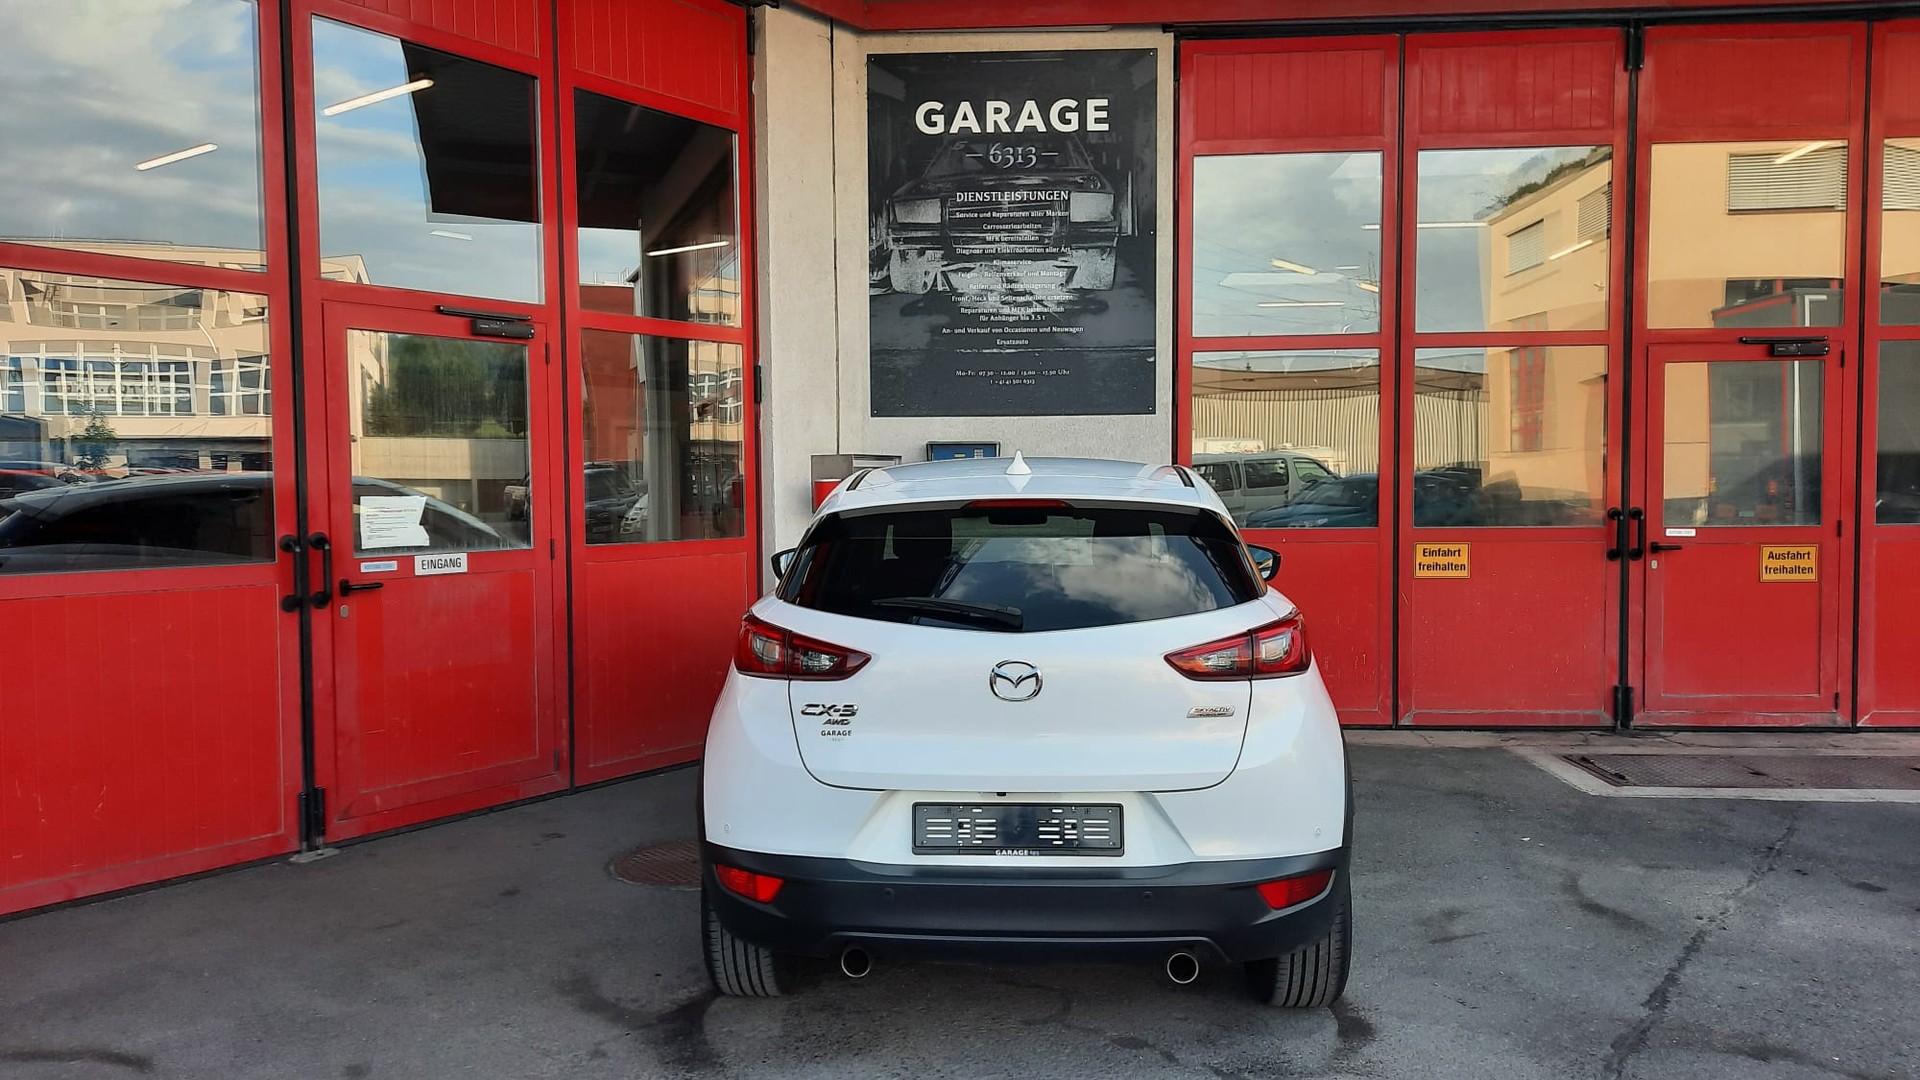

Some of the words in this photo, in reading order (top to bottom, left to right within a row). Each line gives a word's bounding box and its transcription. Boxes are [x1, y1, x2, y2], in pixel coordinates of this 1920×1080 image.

[915, 98, 1110, 135] GARAGE
[989, 142, 1037, 169] 6313
[956, 190, 1069, 202] DIENSTLEISTUNGEN
[992, 211, 1029, 219] Reparaturen
[1045, 209, 1069, 217] Marken
[955, 248, 983, 256] Diagnose
[997, 246, 1045, 254] Elektroarbeiten
[1060, 245, 1071, 253] Art
[990, 315, 1020, 323] Anhänger
[1051, 326, 1084, 334] Neuwagen
[1422, 547, 1461, 558] Einfahrt
[1767, 550, 1811, 561] Ausfahrt
[421, 557, 463, 571] EINGANG
[1418, 561, 1466, 572] freihalten
[1764, 564, 1814, 575] freihalten
[800, 703, 859, 717] CX-3
[822, 718, 851, 726] AWD
[820, 729, 852, 737] GARAGE
